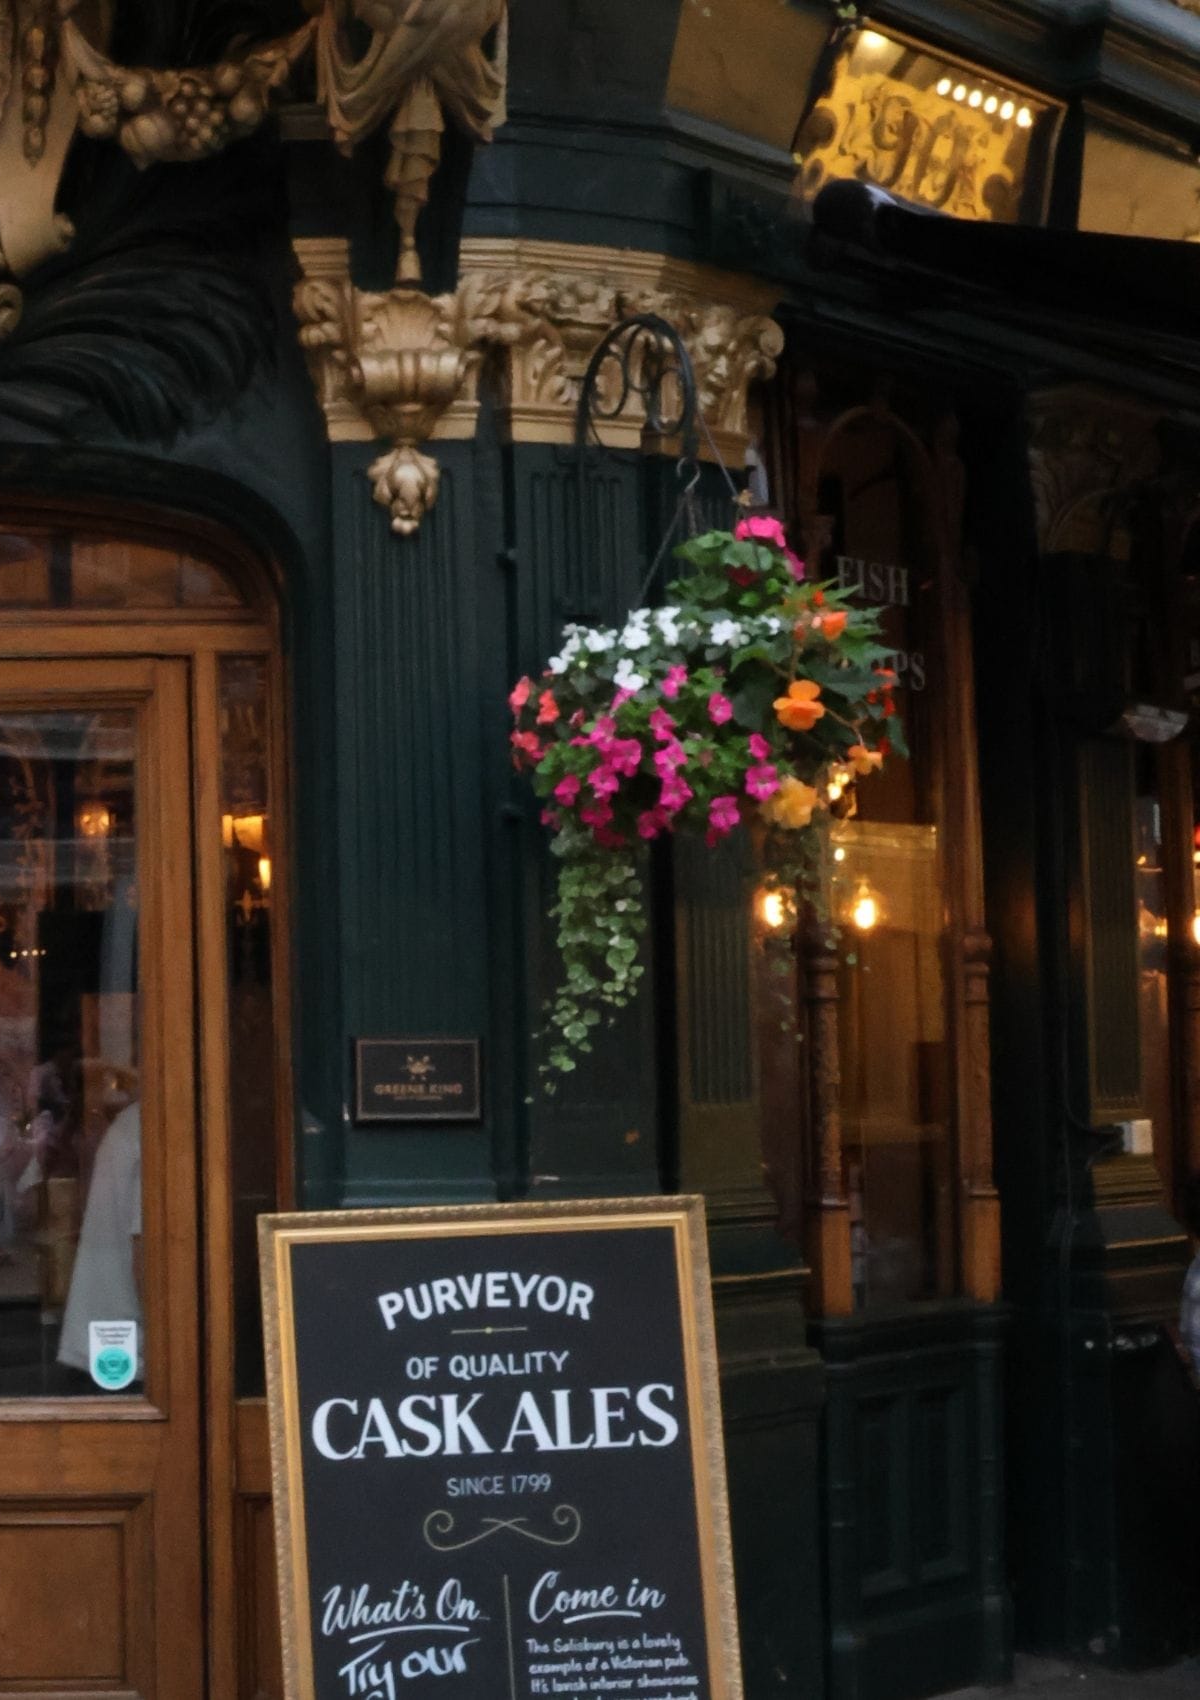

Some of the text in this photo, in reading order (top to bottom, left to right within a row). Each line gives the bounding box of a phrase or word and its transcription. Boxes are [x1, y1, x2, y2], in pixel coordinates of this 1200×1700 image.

[837, 556, 909, 604] FISH
[378, 1272, 594, 1330] PURVEYOR
[406, 1351, 569, 1381] OF QUALITY
[311, 1383, 680, 1461] CASK ALES
[446, 1474, 552, 1496] SINCE 1799
[322, 1578, 480, 1636] What's On
[528, 1571, 666, 1624] Come in
[526, 1639, 549, 1653] The
[643, 1632, 681, 1652] lovely
[529, 1658, 583, 1676] example
[338, 1638, 481, 1700] Try our
